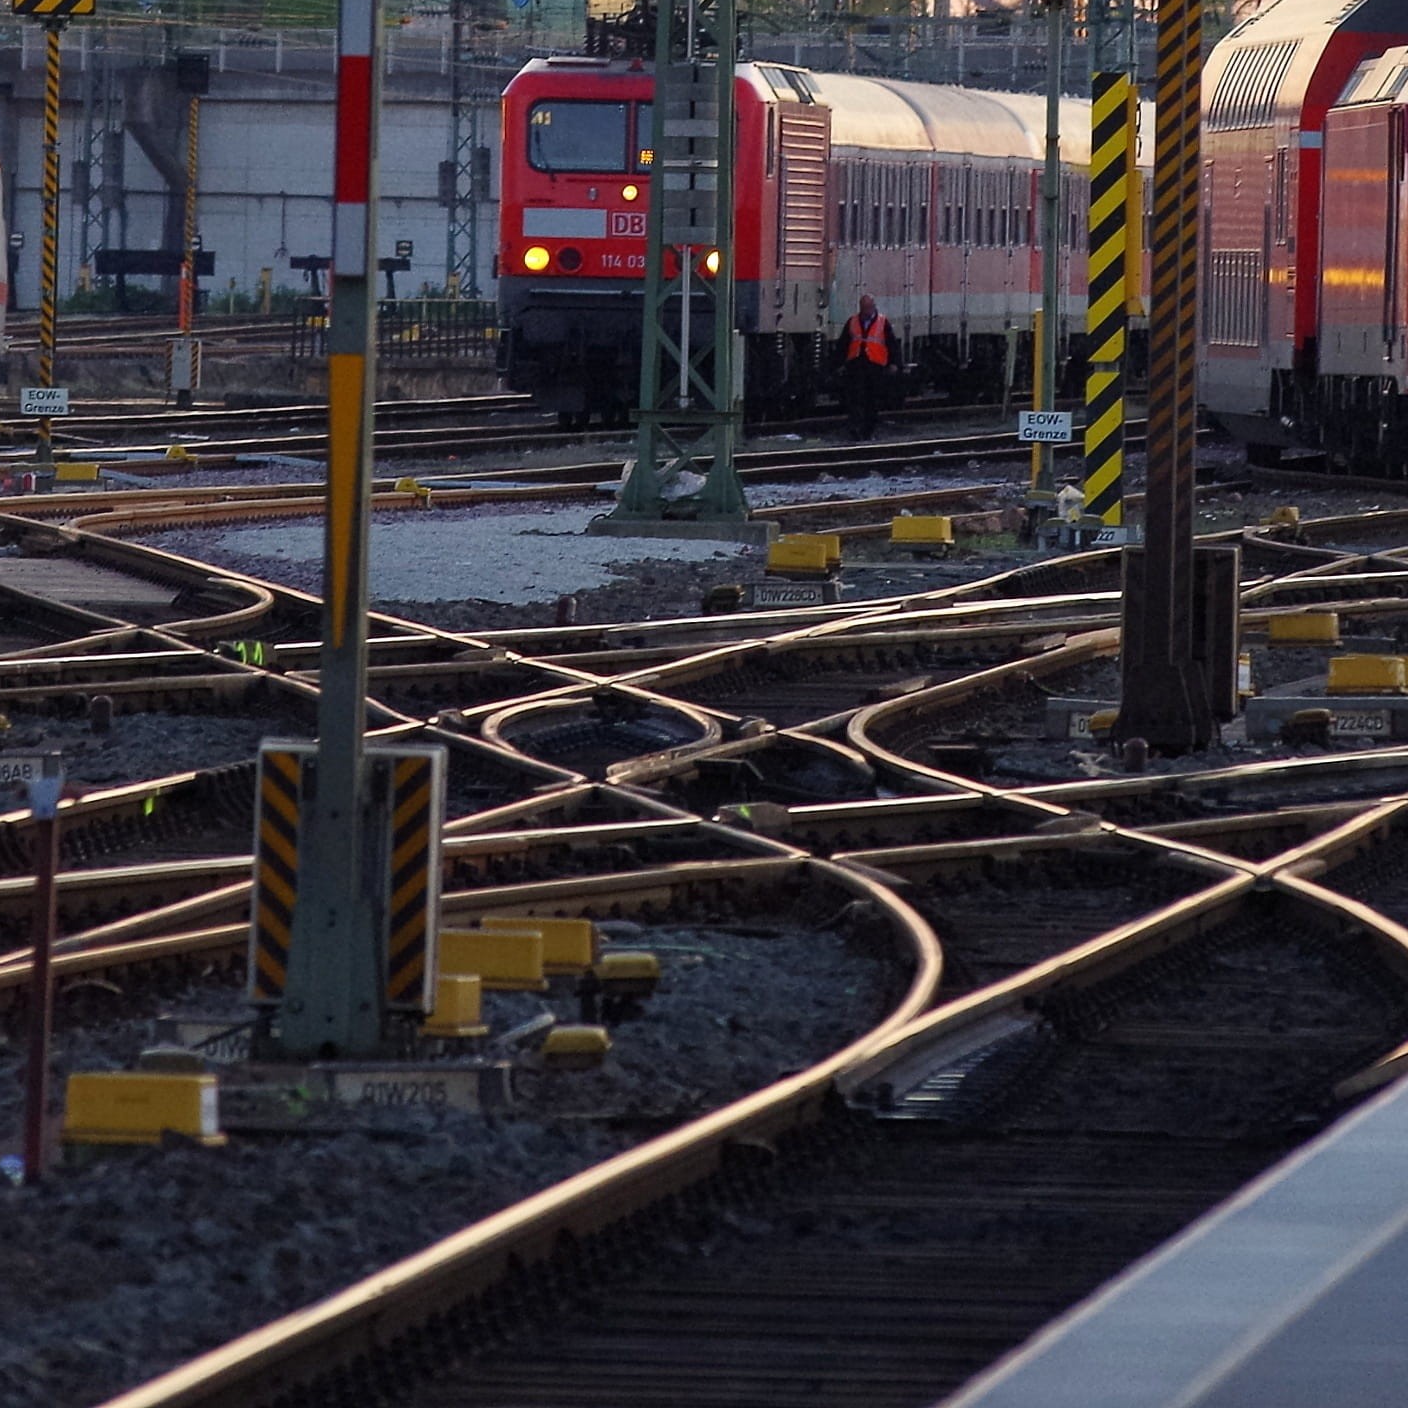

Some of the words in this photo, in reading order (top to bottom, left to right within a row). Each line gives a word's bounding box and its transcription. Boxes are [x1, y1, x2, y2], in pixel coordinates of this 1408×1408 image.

[614, 214, 644, 234] DB
[601, 254, 622, 268] 114
[627, 255, 645, 268] 03
[24, 403, 65, 413] Grenze
[1027, 414, 1064, 425] EOW-
[1023, 427, 1068, 440] Grenze
